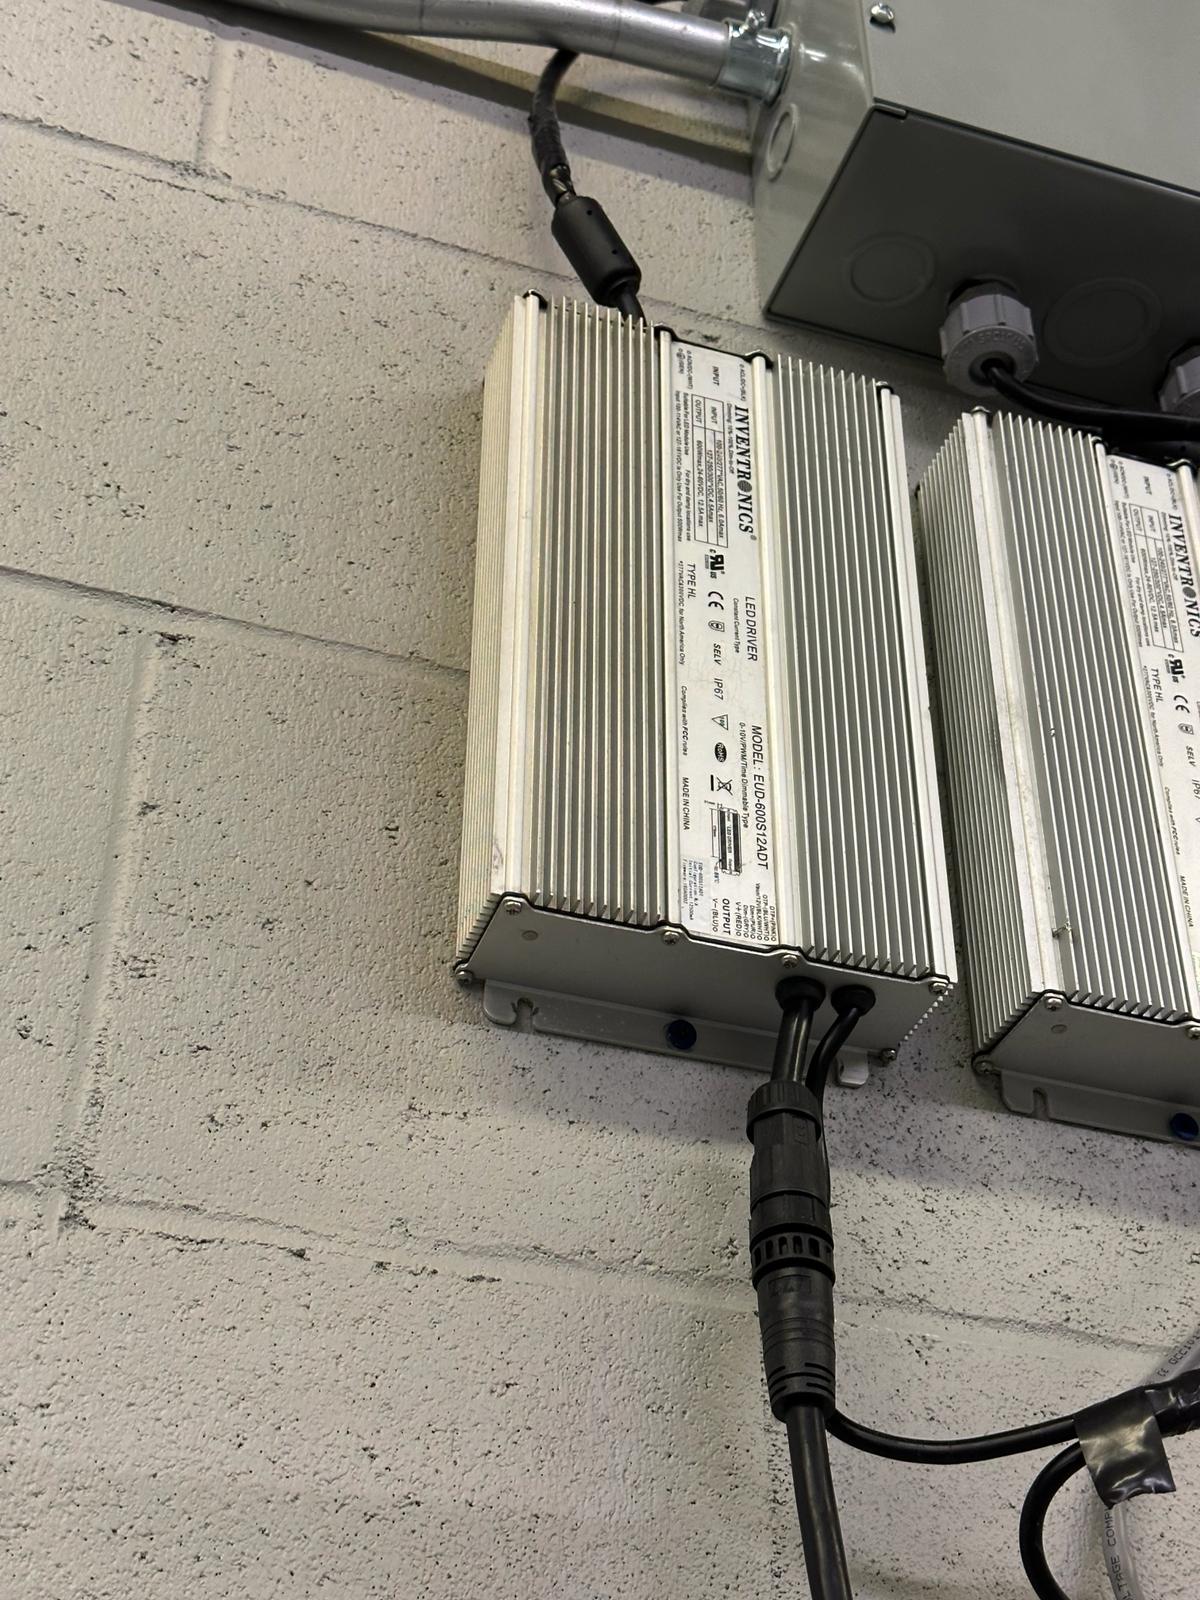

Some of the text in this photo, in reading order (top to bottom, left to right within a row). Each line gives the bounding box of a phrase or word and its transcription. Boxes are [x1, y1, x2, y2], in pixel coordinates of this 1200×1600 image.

[712, 365, 720, 386] INPUT
[687, 562, 696, 600] TYPE HL
[745, 596, 758, 662] LED DRIVER
[713, 643, 722, 666] SELV
[713, 677, 723, 701] IP67
[1151, 667, 1164, 704] TYPE HL
[1186, 745, 1196, 767] SELV
[682, 798, 690, 807] IN
[741, 778, 749, 812] Dimmable
[751, 725, 768, 870] MODEL: EUD-600S12ADT
[742, 812, 750, 829] Type
[722, 898, 731, 935] OUTPUT
[1180, 876, 1193, 928] MADE IN CHINA
[1110, 1555, 1132, 1600] LTAGE
